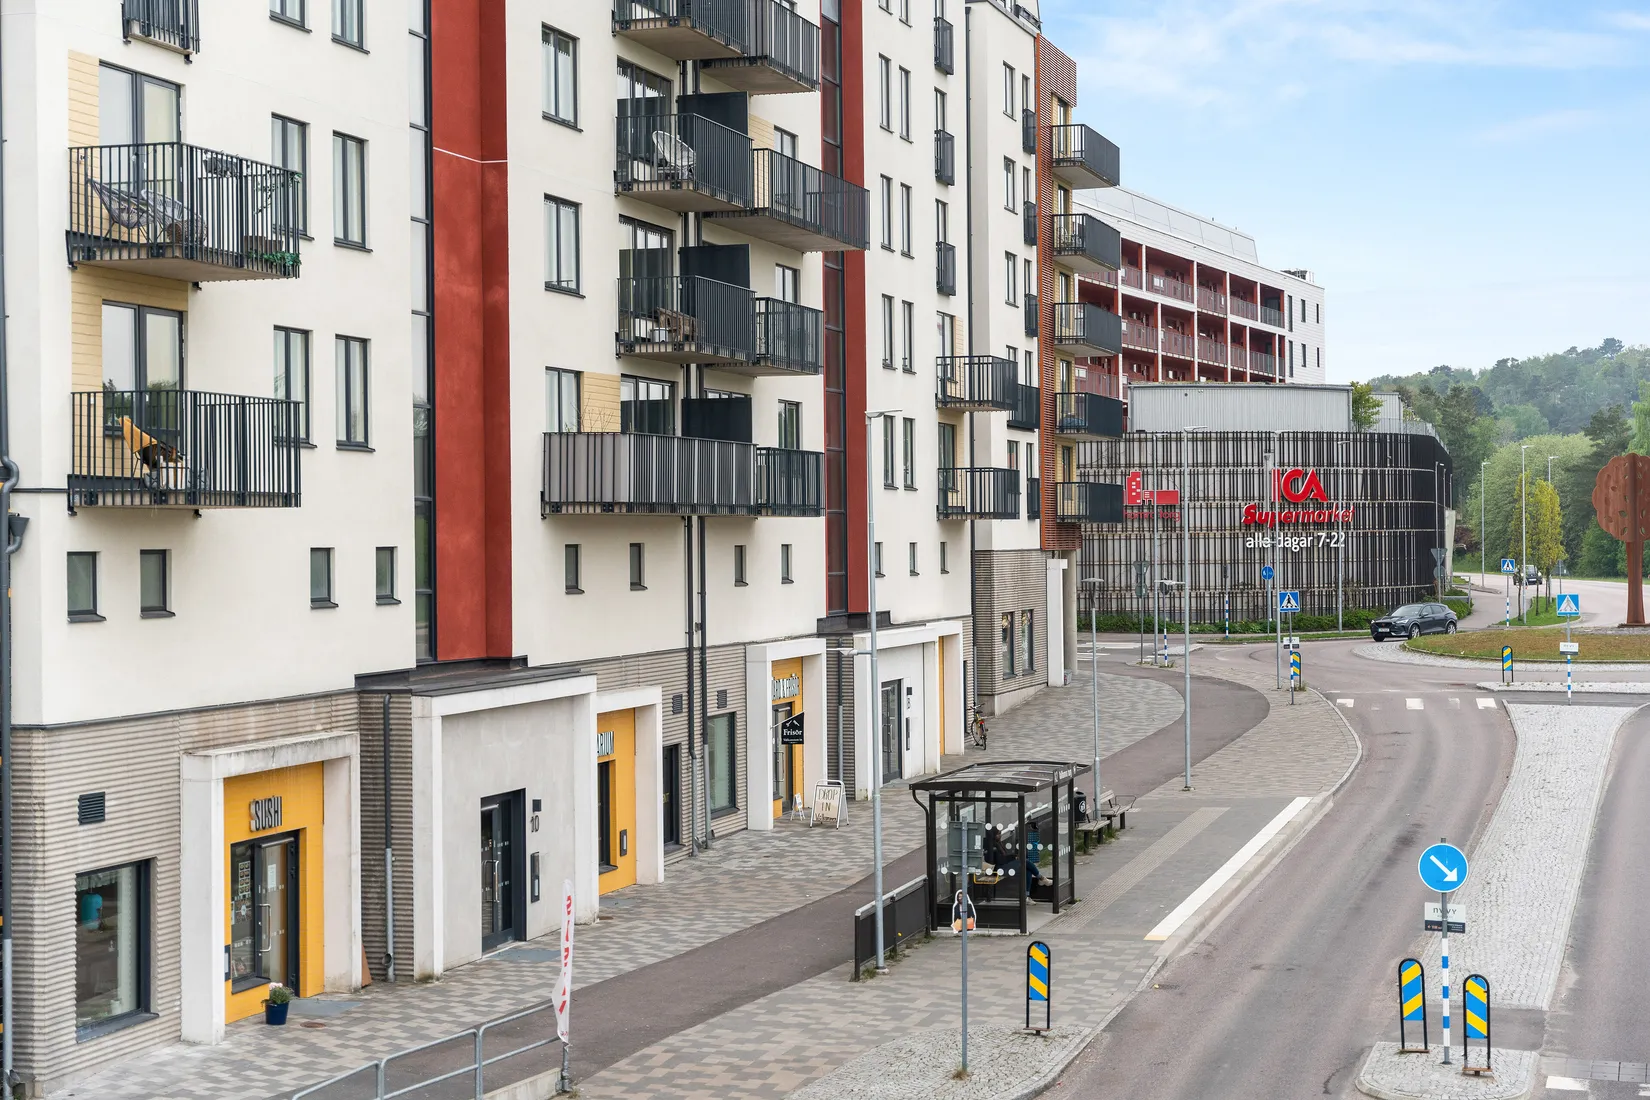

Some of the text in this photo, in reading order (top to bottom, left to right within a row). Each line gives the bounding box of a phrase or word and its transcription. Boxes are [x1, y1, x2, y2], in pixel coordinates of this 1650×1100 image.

[1271, 468, 1329, 502] ICA
[1241, 502, 1355, 529] Supermarket
[1246, 532, 1346, 552] alla dagar 7-22
[818, 788, 839, 801] DROP
[250, 796, 282, 832] SUSHI
[821, 802, 831, 812] IN
[530, 815, 540, 833] 10
